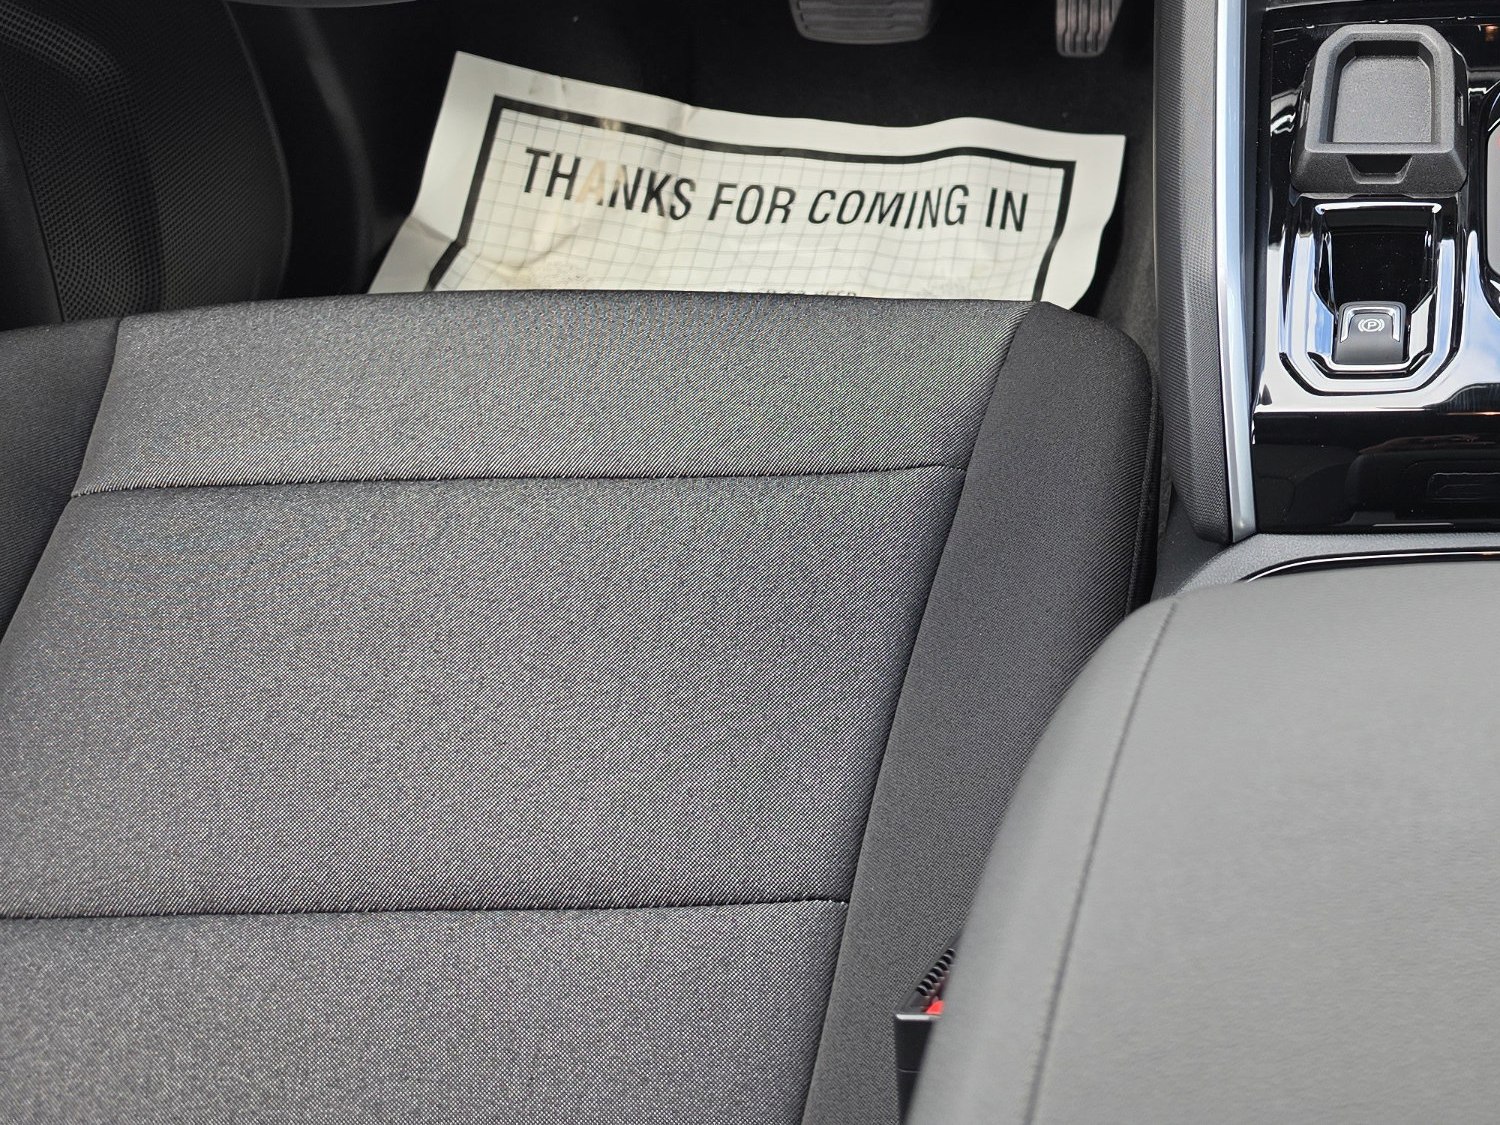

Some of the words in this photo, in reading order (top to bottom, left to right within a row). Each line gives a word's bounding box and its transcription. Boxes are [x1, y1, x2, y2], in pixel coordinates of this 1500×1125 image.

[524, 147, 697, 221] THANKS
[708, 182, 796, 226] FOR
[807, 185, 969, 231] COMING
[985, 188, 1030, 232] IN
